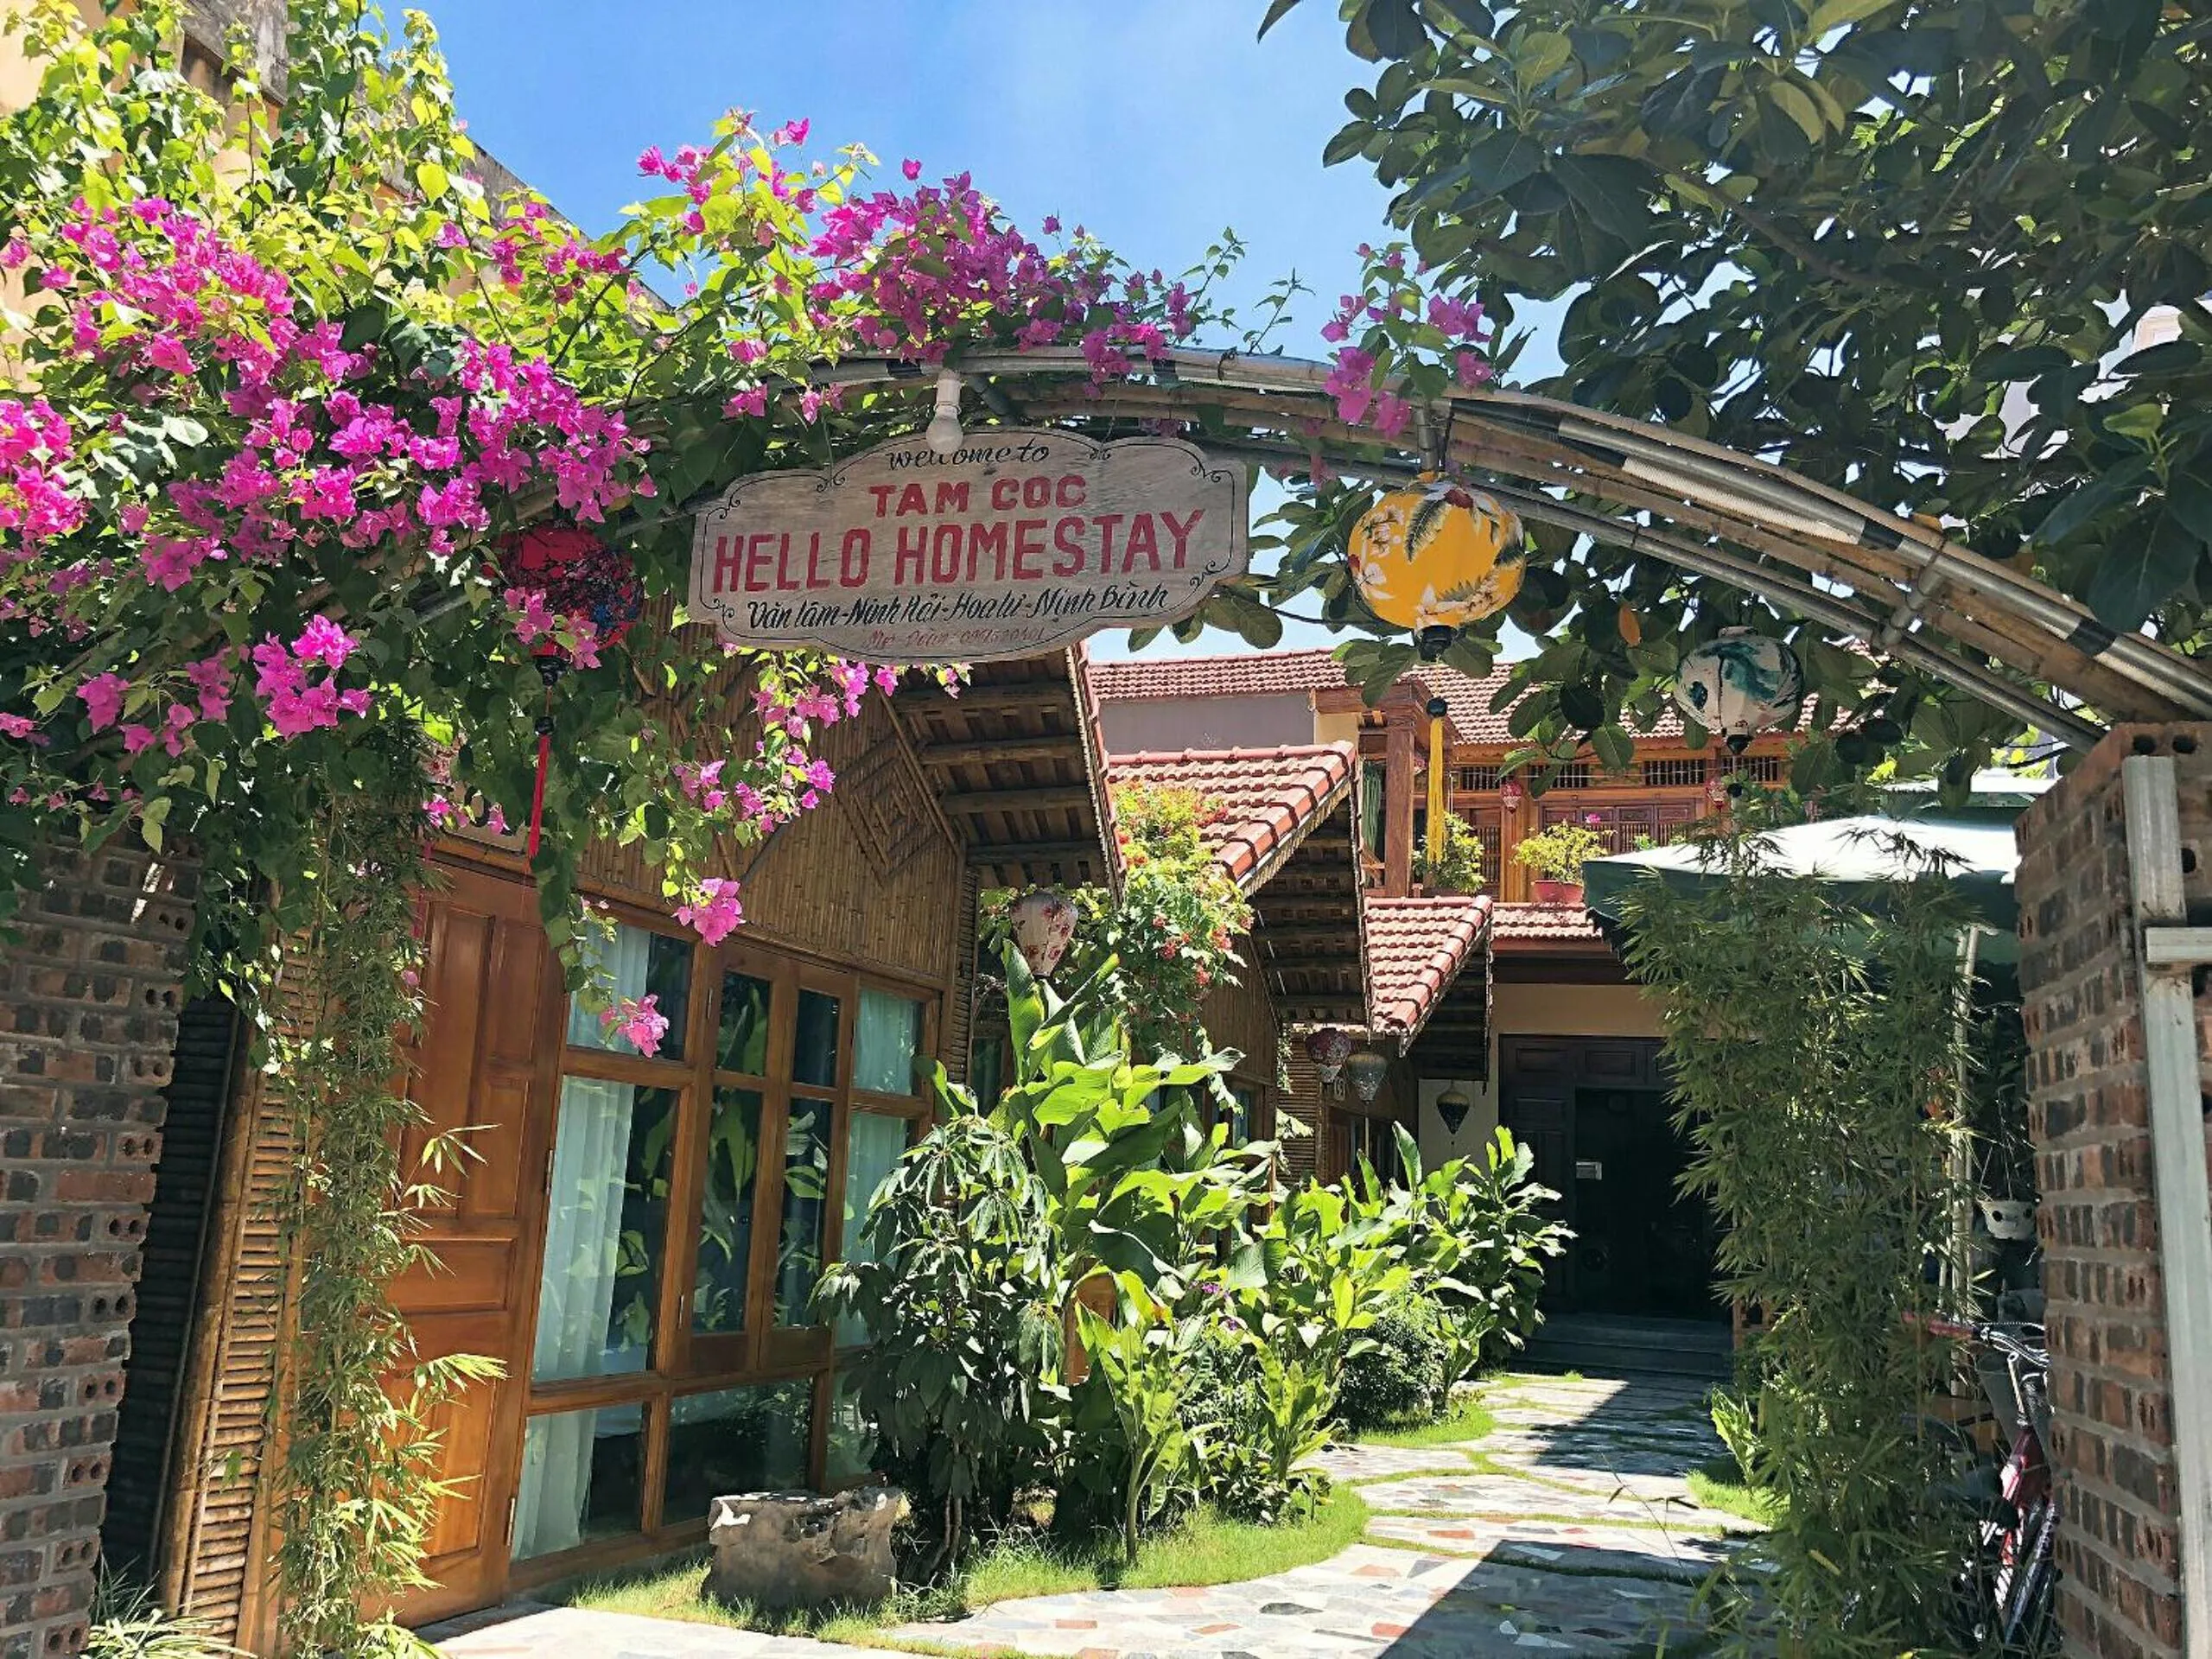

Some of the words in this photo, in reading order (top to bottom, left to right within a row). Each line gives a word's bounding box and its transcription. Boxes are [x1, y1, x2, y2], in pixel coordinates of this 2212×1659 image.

[1017, 437, 1050, 462] to
[869, 481, 970, 518] TAM
[991, 475, 1086, 512] COC
[713, 528, 872, 594] HELLO
[894, 508, 1205, 586] HOMESTAY
